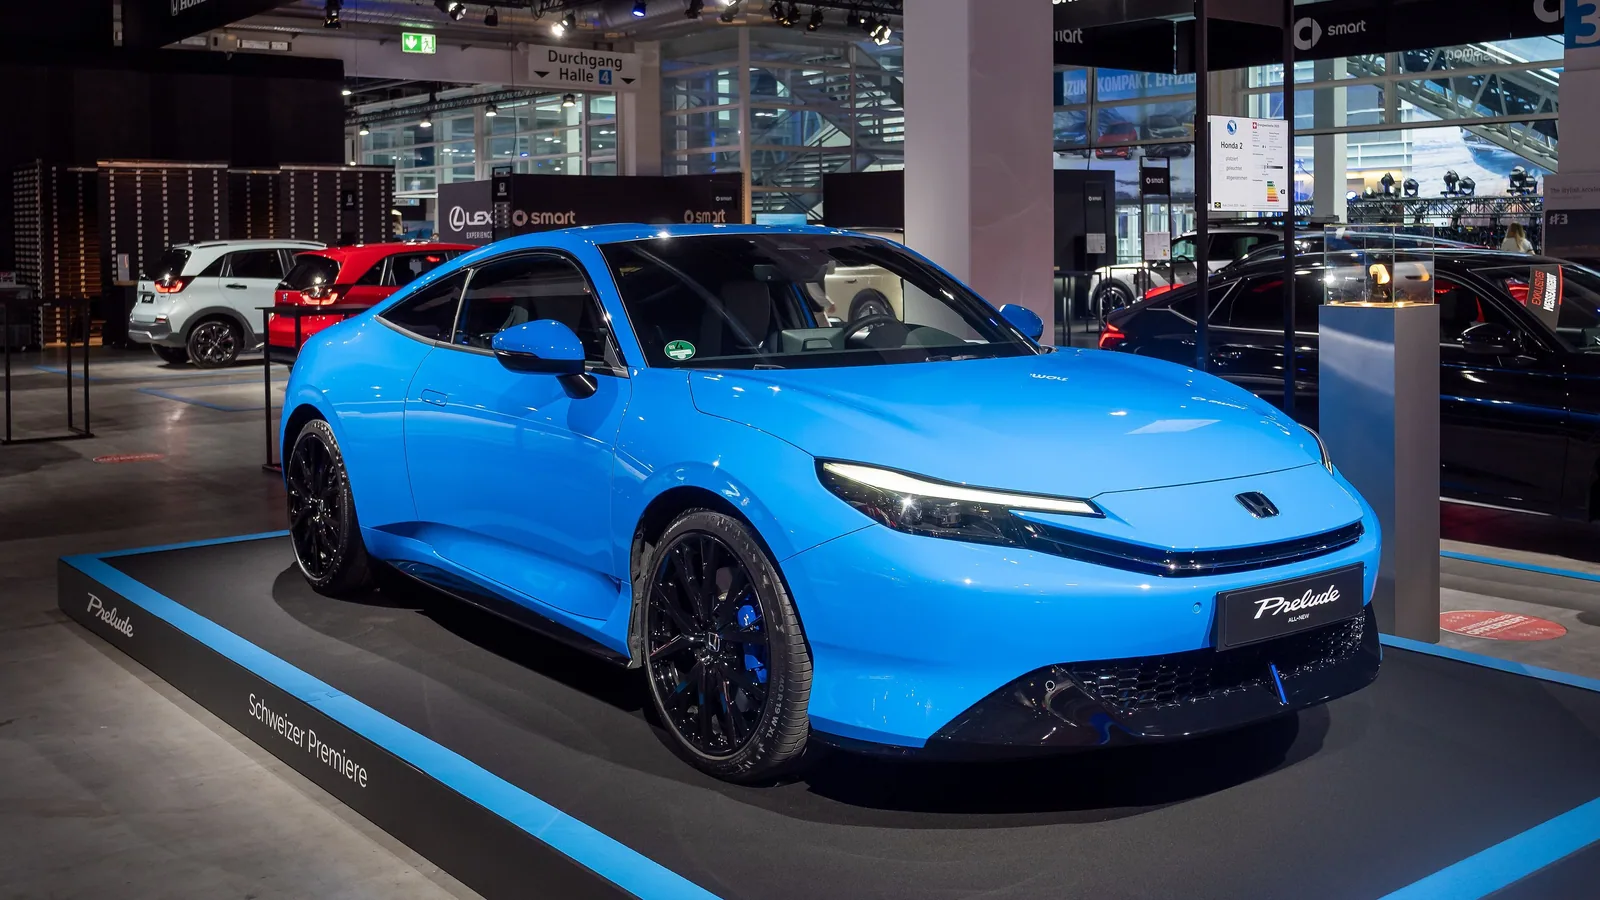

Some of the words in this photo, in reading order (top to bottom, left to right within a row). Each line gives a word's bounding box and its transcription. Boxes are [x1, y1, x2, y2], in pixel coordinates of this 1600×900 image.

[1327, 20, 1366, 36] smart
[548, 50, 622, 72] Durchgang
[559, 68, 594, 82] Halle
[601, 71, 610, 84] 4
[1220, 141, 1239, 149] Honda
[466, 210, 493, 226] LEX
[530, 209, 576, 225] smart
[695, 209, 726, 223] smart
[1549, 213, 1568, 225] #3
[1253, 584, 1341, 620] Prelude
[86, 591, 134, 638] Prelude
[248, 693, 306, 748] Schweizer
[308, 729, 368, 788] Premiere
